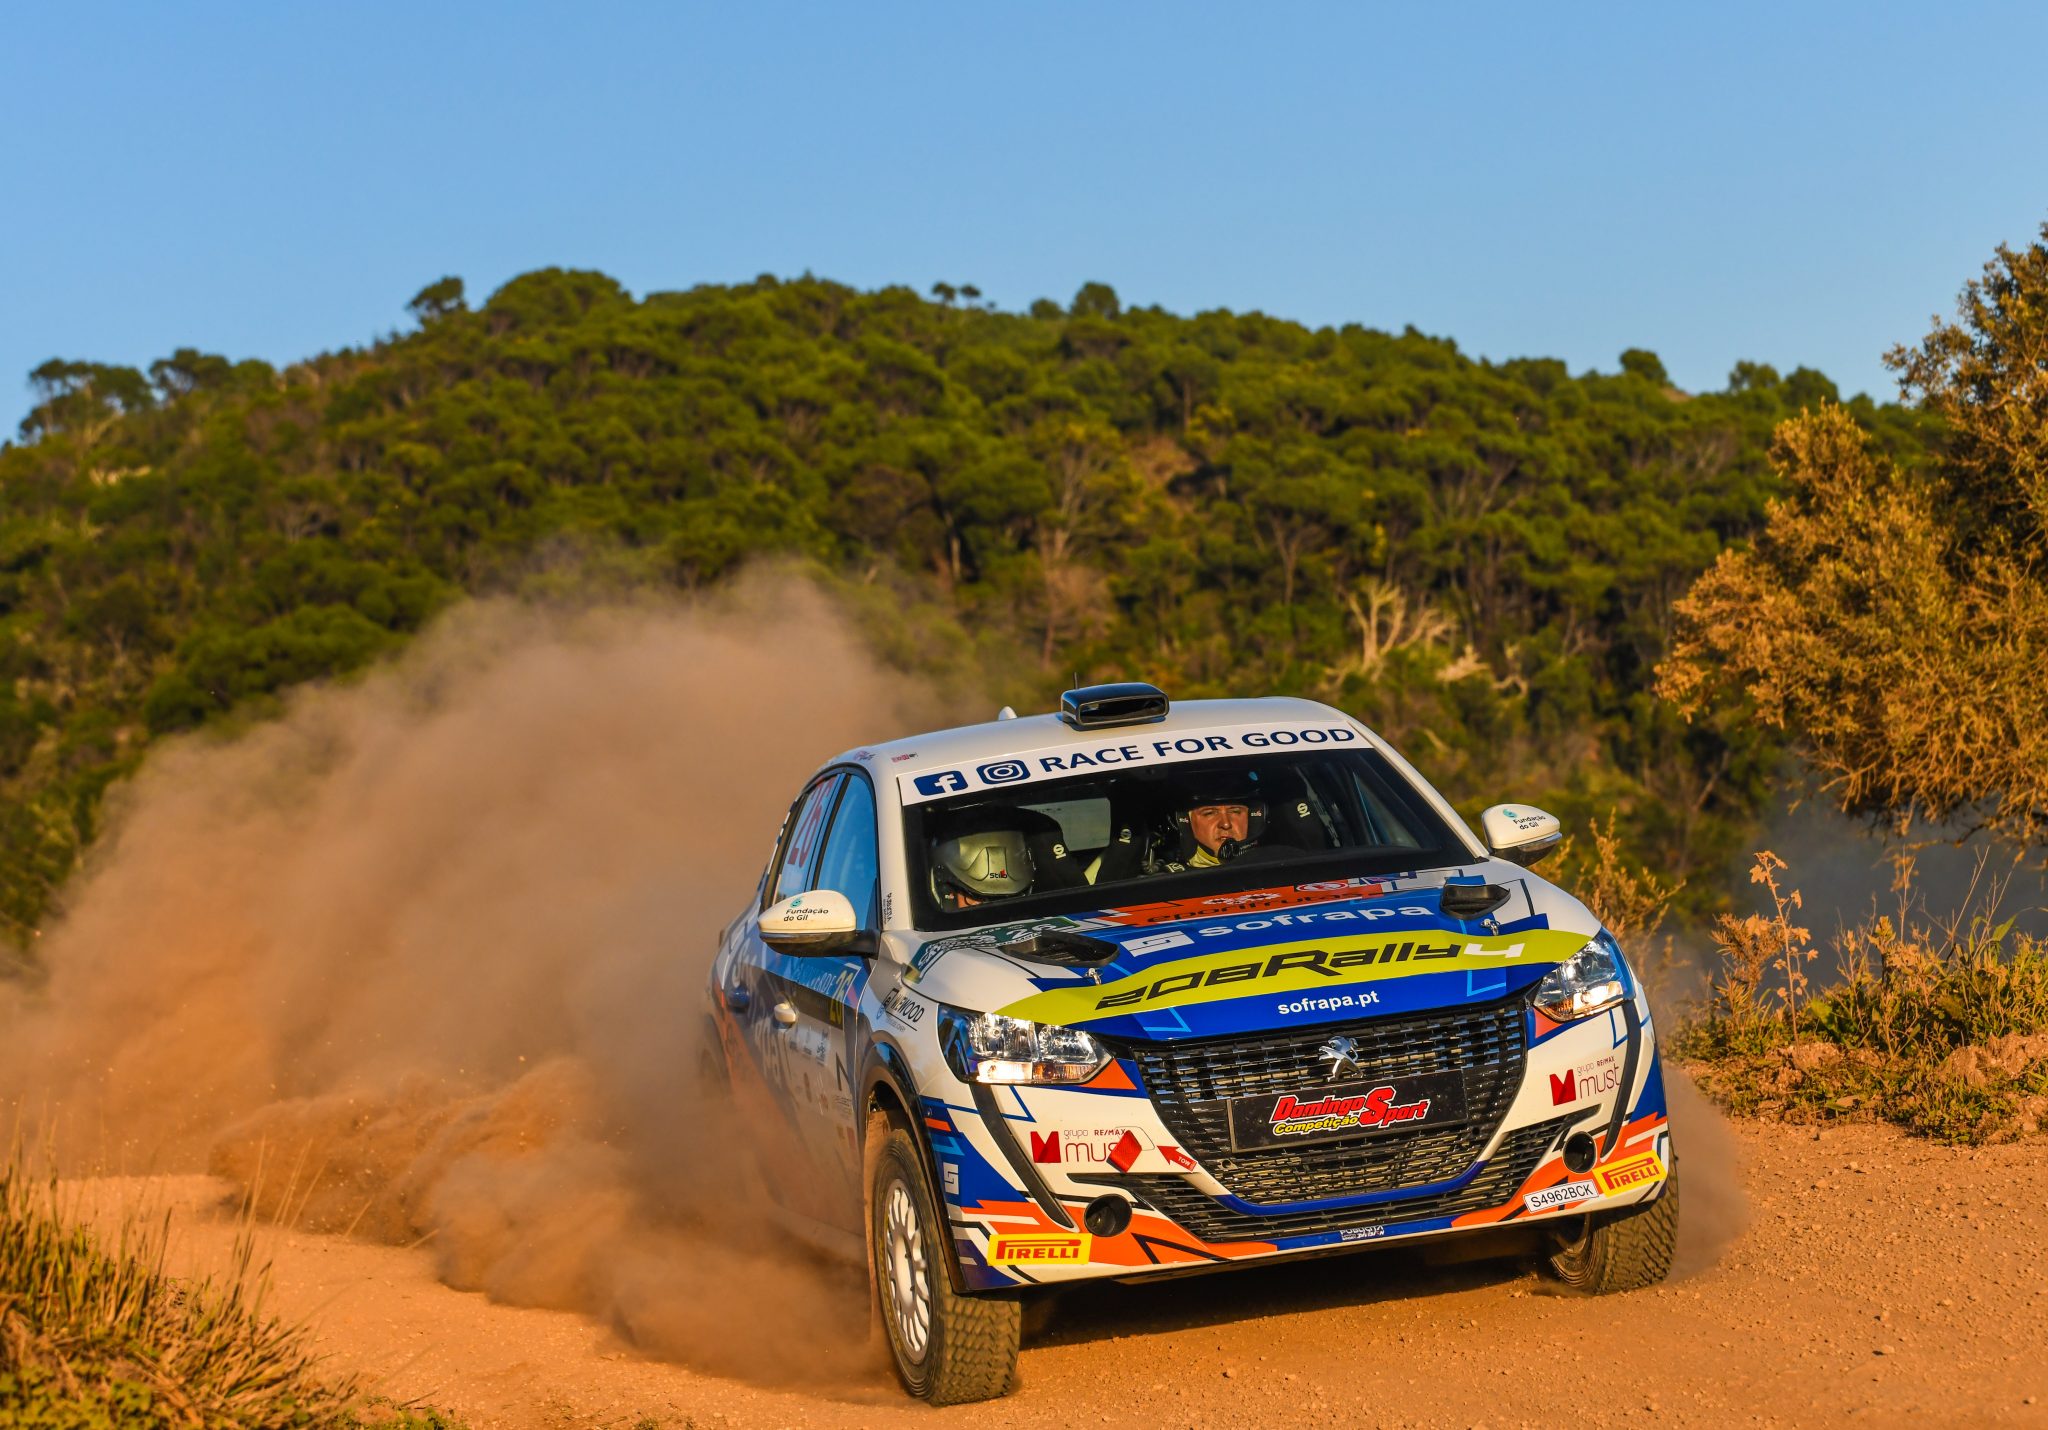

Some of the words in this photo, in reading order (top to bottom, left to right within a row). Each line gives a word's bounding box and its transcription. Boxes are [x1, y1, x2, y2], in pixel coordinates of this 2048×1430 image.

[1039, 745, 1143, 773] RACE
[1153, 735, 1233, 762] FOR
[1241, 728, 1355, 754] GOOD
[1197, 905, 1434, 937] sofrapa
[1278, 990, 1380, 1015] sofrapa.pt
[1577, 1062, 1595, 1077] grupo
[1596, 1056, 1615, 1067] RE/MAX
[1579, 1064, 1621, 1099] must
[1064, 1129, 1089, 1140] grupo
[1094, 1128, 1126, 1136] RE/MAX
[1273, 1115, 1359, 1136] Competição
[1065, 1142, 1119, 1163] mu
[1178, 1155, 1191, 1167] TOW
[1601, 1157, 1661, 1191] PIRELLI
[1530, 1183, 1595, 1208] S4962BCK
[996, 1239, 1082, 1260] PIRELLI
